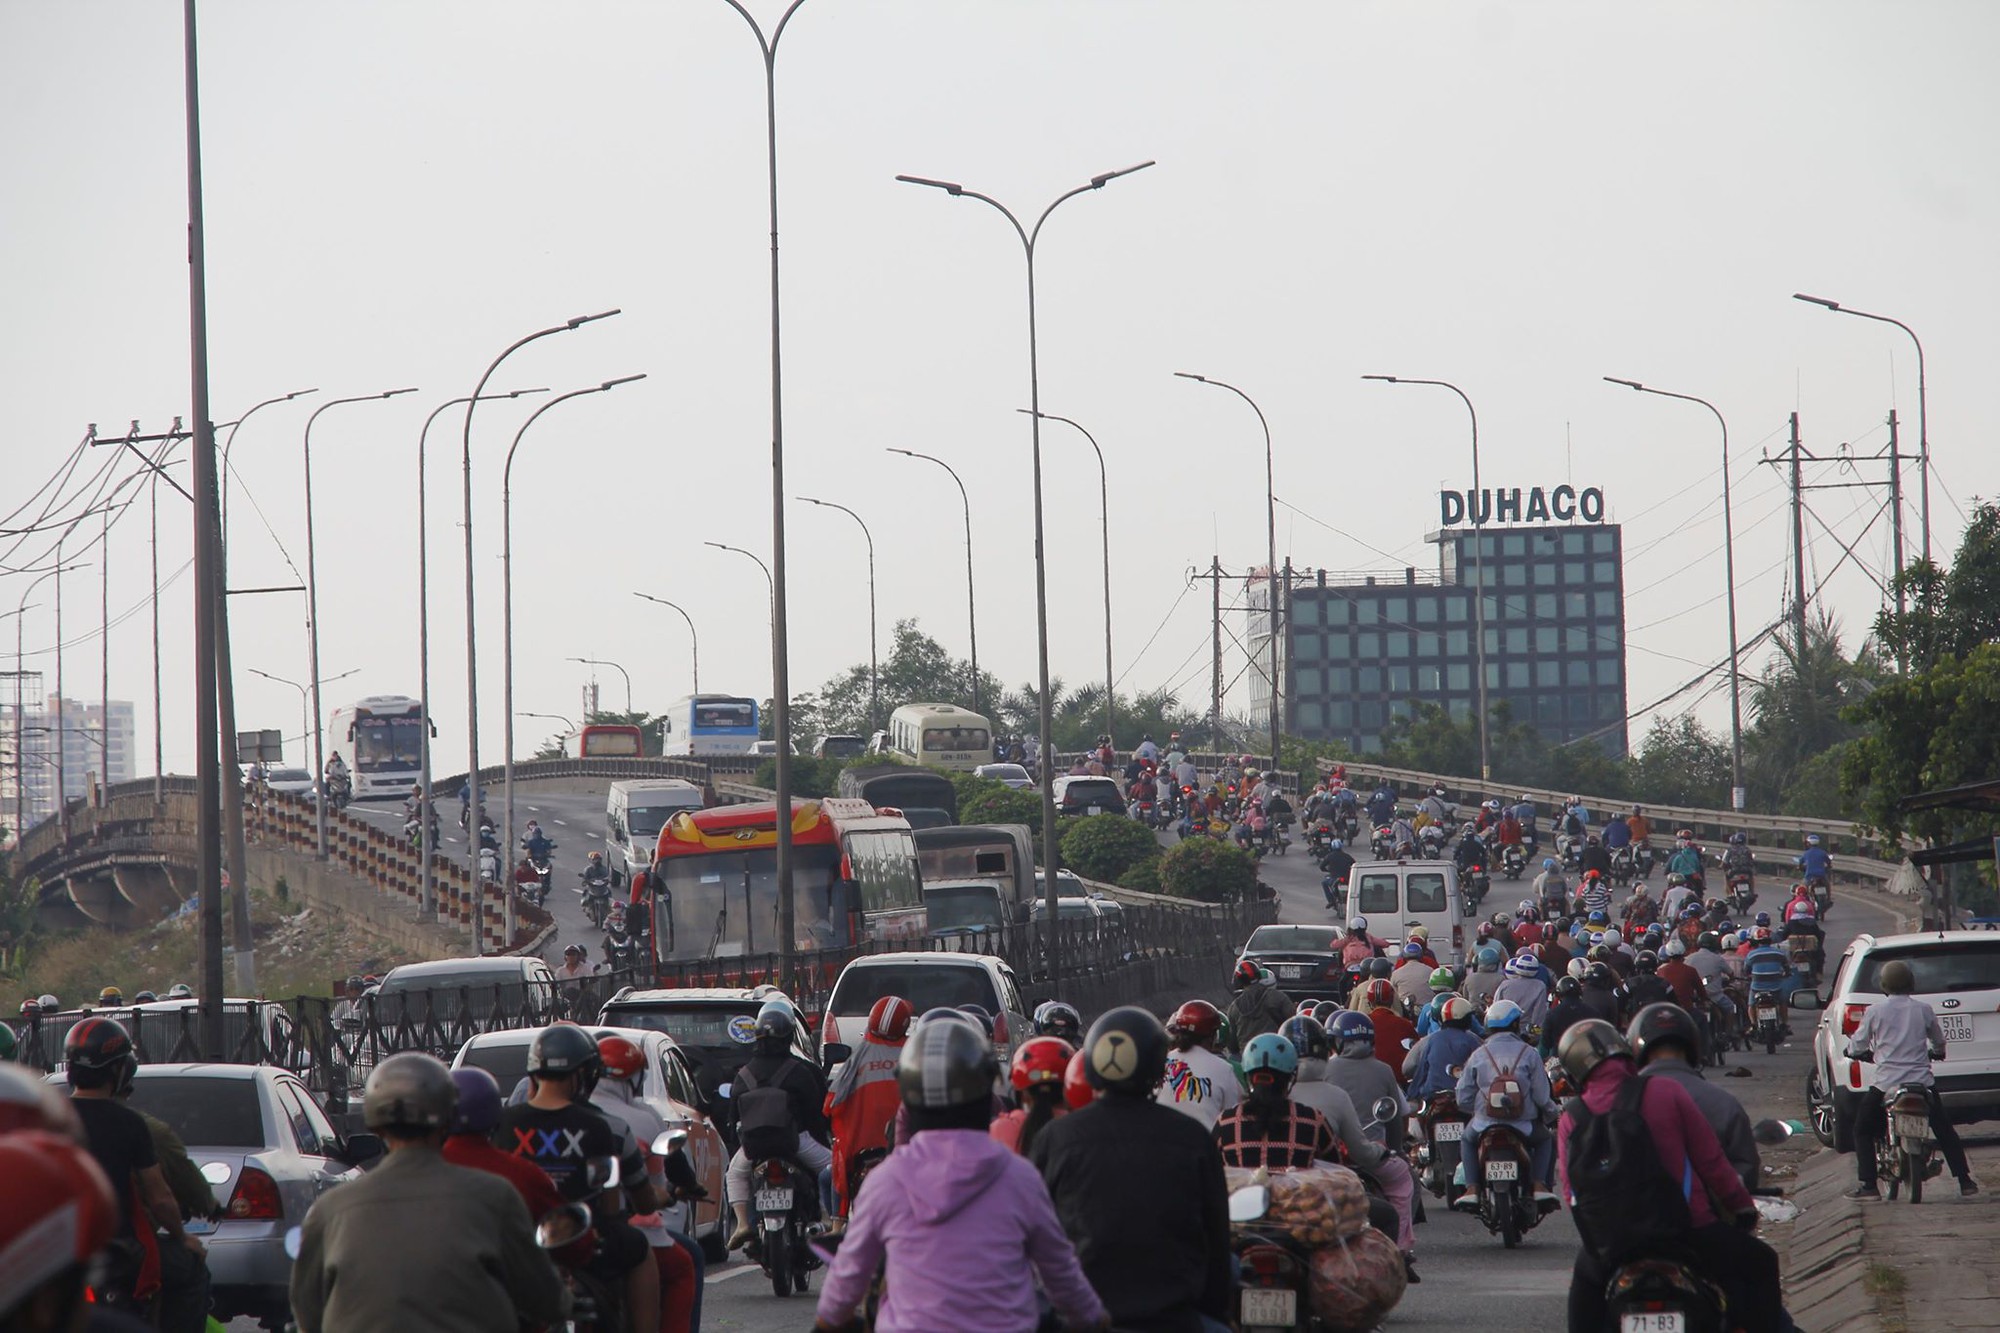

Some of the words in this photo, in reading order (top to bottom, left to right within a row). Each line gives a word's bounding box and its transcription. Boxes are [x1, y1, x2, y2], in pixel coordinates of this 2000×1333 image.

[1440, 484, 1605, 526] DUHACO
[1942, 1016, 1963, 1029] 51H
[1943, 1028, 1972, 1040] 20.88
[1632, 1315, 1675, 1332] 71-B3
